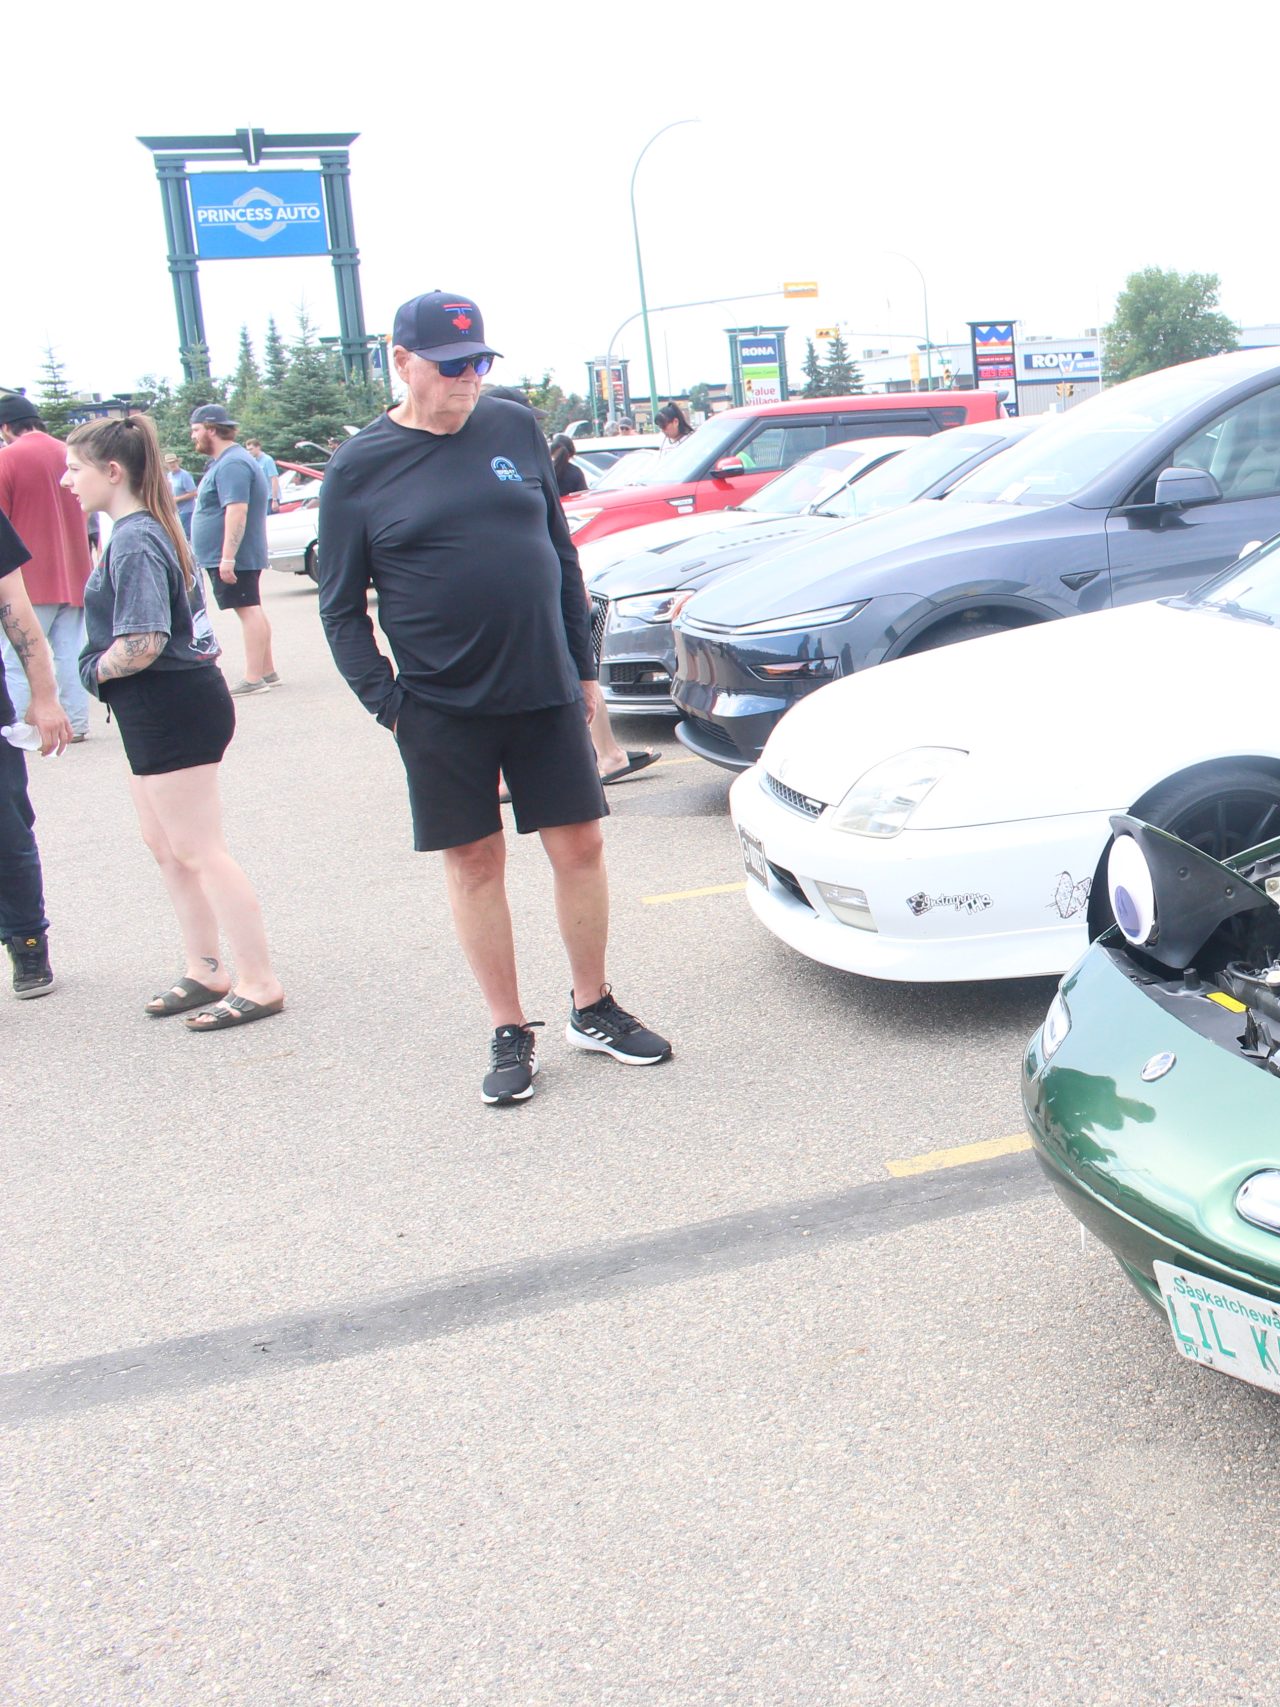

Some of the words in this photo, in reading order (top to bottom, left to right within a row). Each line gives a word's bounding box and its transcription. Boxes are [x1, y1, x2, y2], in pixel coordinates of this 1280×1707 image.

[197, 207, 273, 224] PRINCESS
[276, 205, 321, 221] AUTO
[742, 346, 775, 356] RONA
[752, 386, 776, 396] alue
[1167, 1295, 1236, 1358] LIL
[1183, 1343, 1200, 1360] PV
